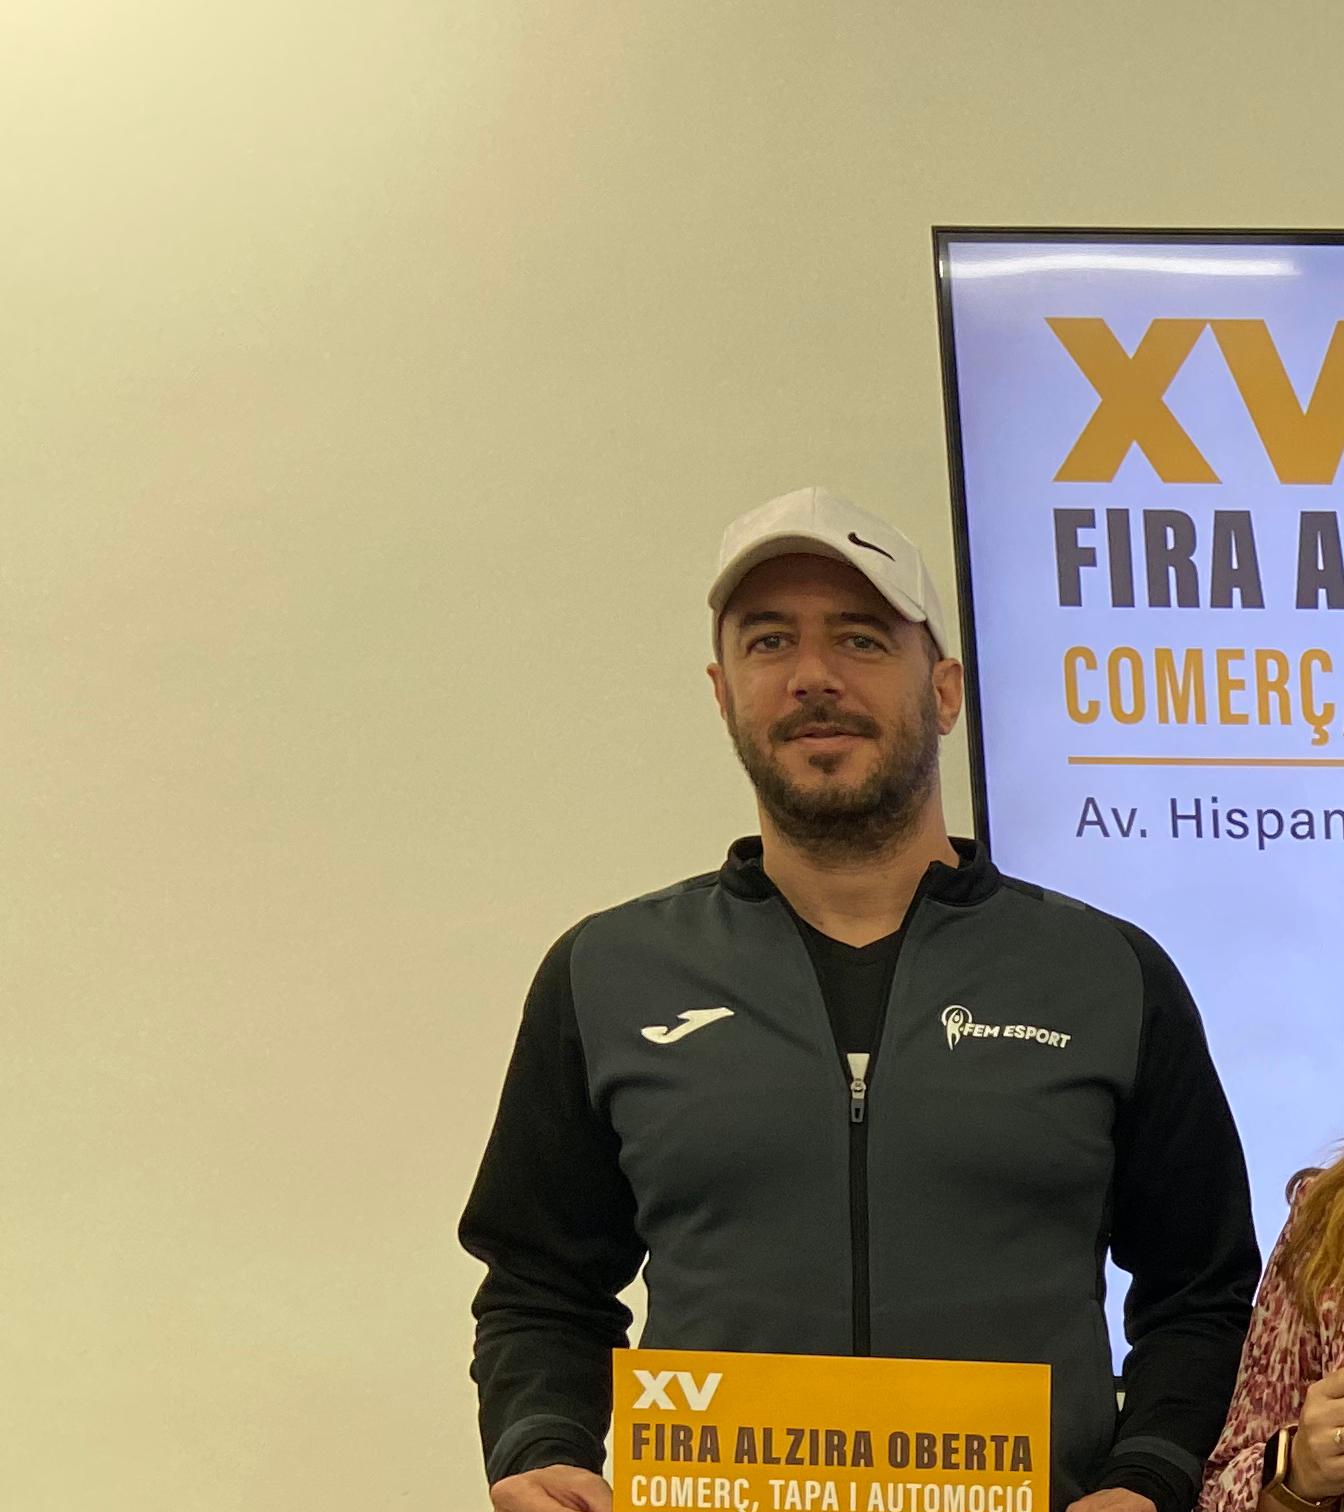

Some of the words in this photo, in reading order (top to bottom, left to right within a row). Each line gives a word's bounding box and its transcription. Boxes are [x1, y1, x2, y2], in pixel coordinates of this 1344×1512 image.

[1054, 508, 1264, 610] FIRA
[1076, 800, 1147, 839] Av.
[964, 1022, 1000, 1038] FEM
[1003, 1024, 1072, 1049] ESPORT
[632, 1370, 723, 1410] XV
[632, 1423, 720, 1463] FIRA
[735, 1427, 874, 1468] ALZIRA
[888, 1432, 1032, 1472] OBERTA
[769, 1480, 839, 1511] TAPA
[850, 1483, 856, 1511] I
